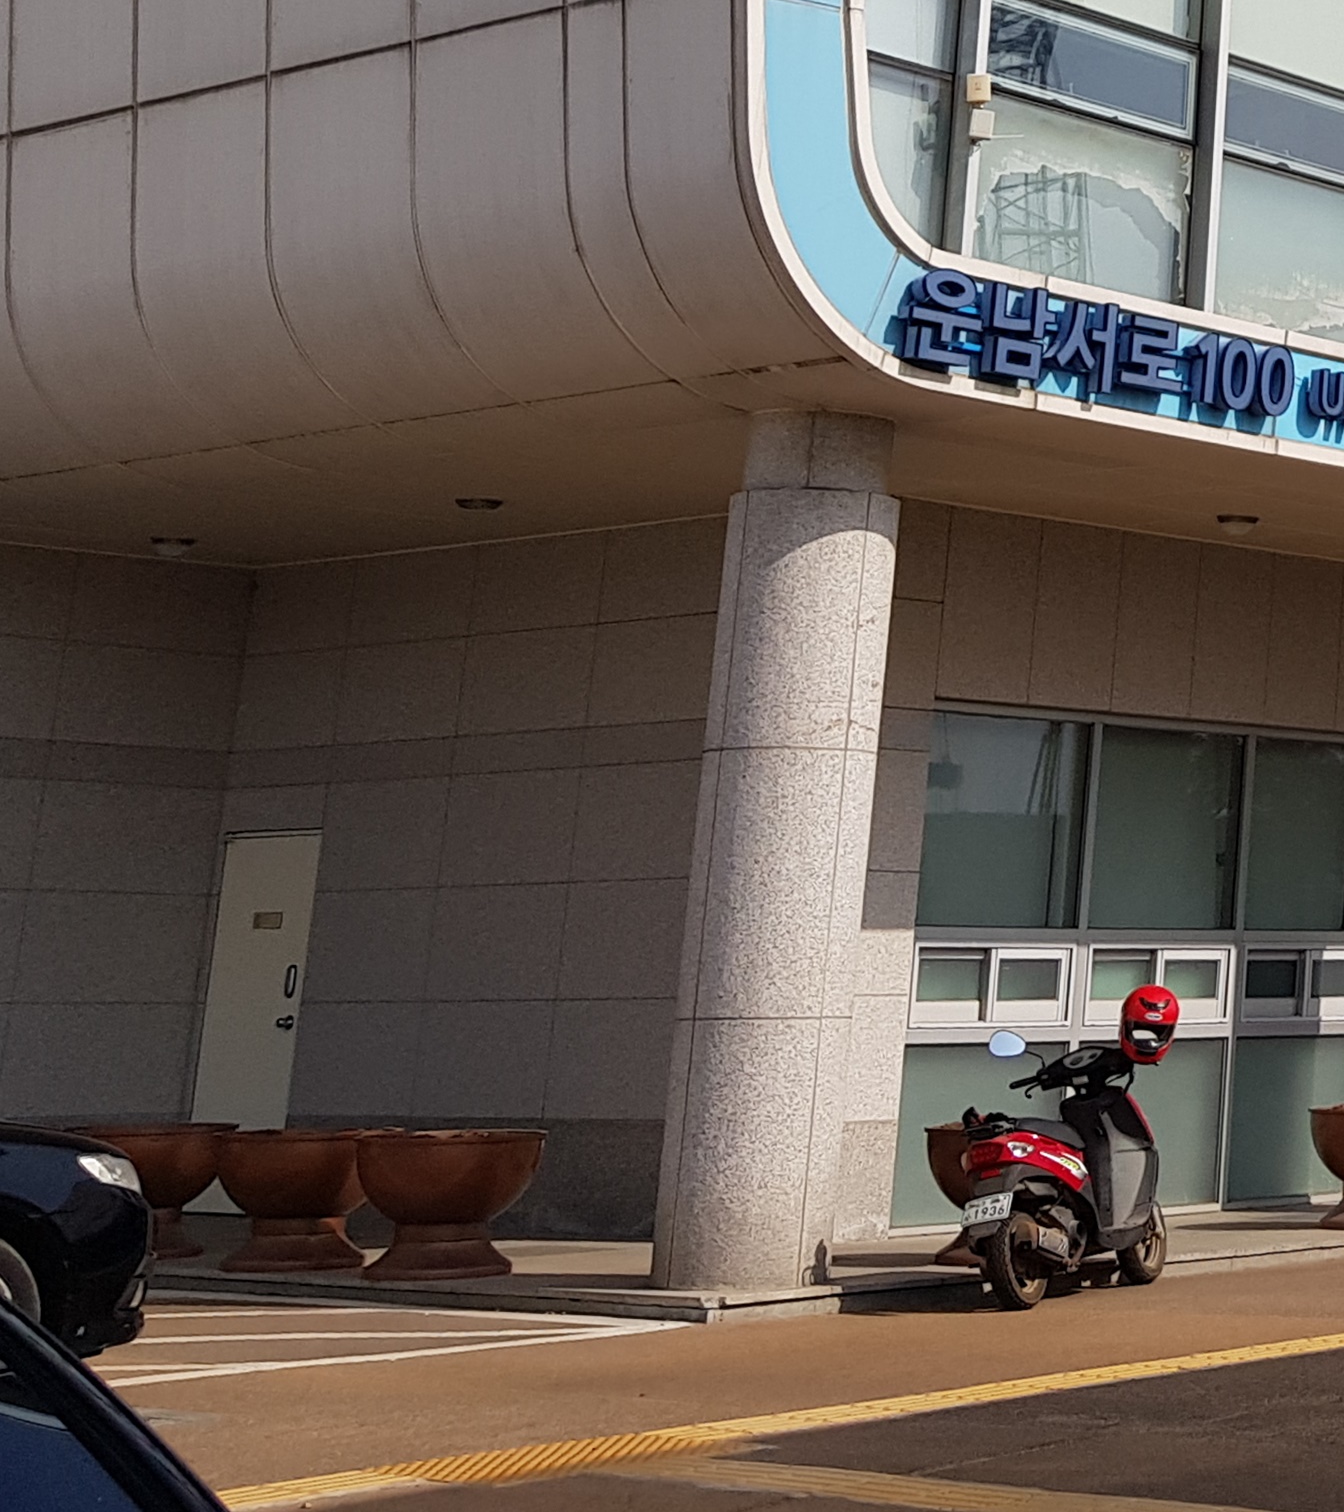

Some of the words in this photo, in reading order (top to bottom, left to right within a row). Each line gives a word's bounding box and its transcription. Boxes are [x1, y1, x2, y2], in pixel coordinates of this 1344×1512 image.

[901, 268, 1184, 394] 운남서로
[1190, 332, 1295, 418] 100
[974, 1205, 1005, 1219] 1936
